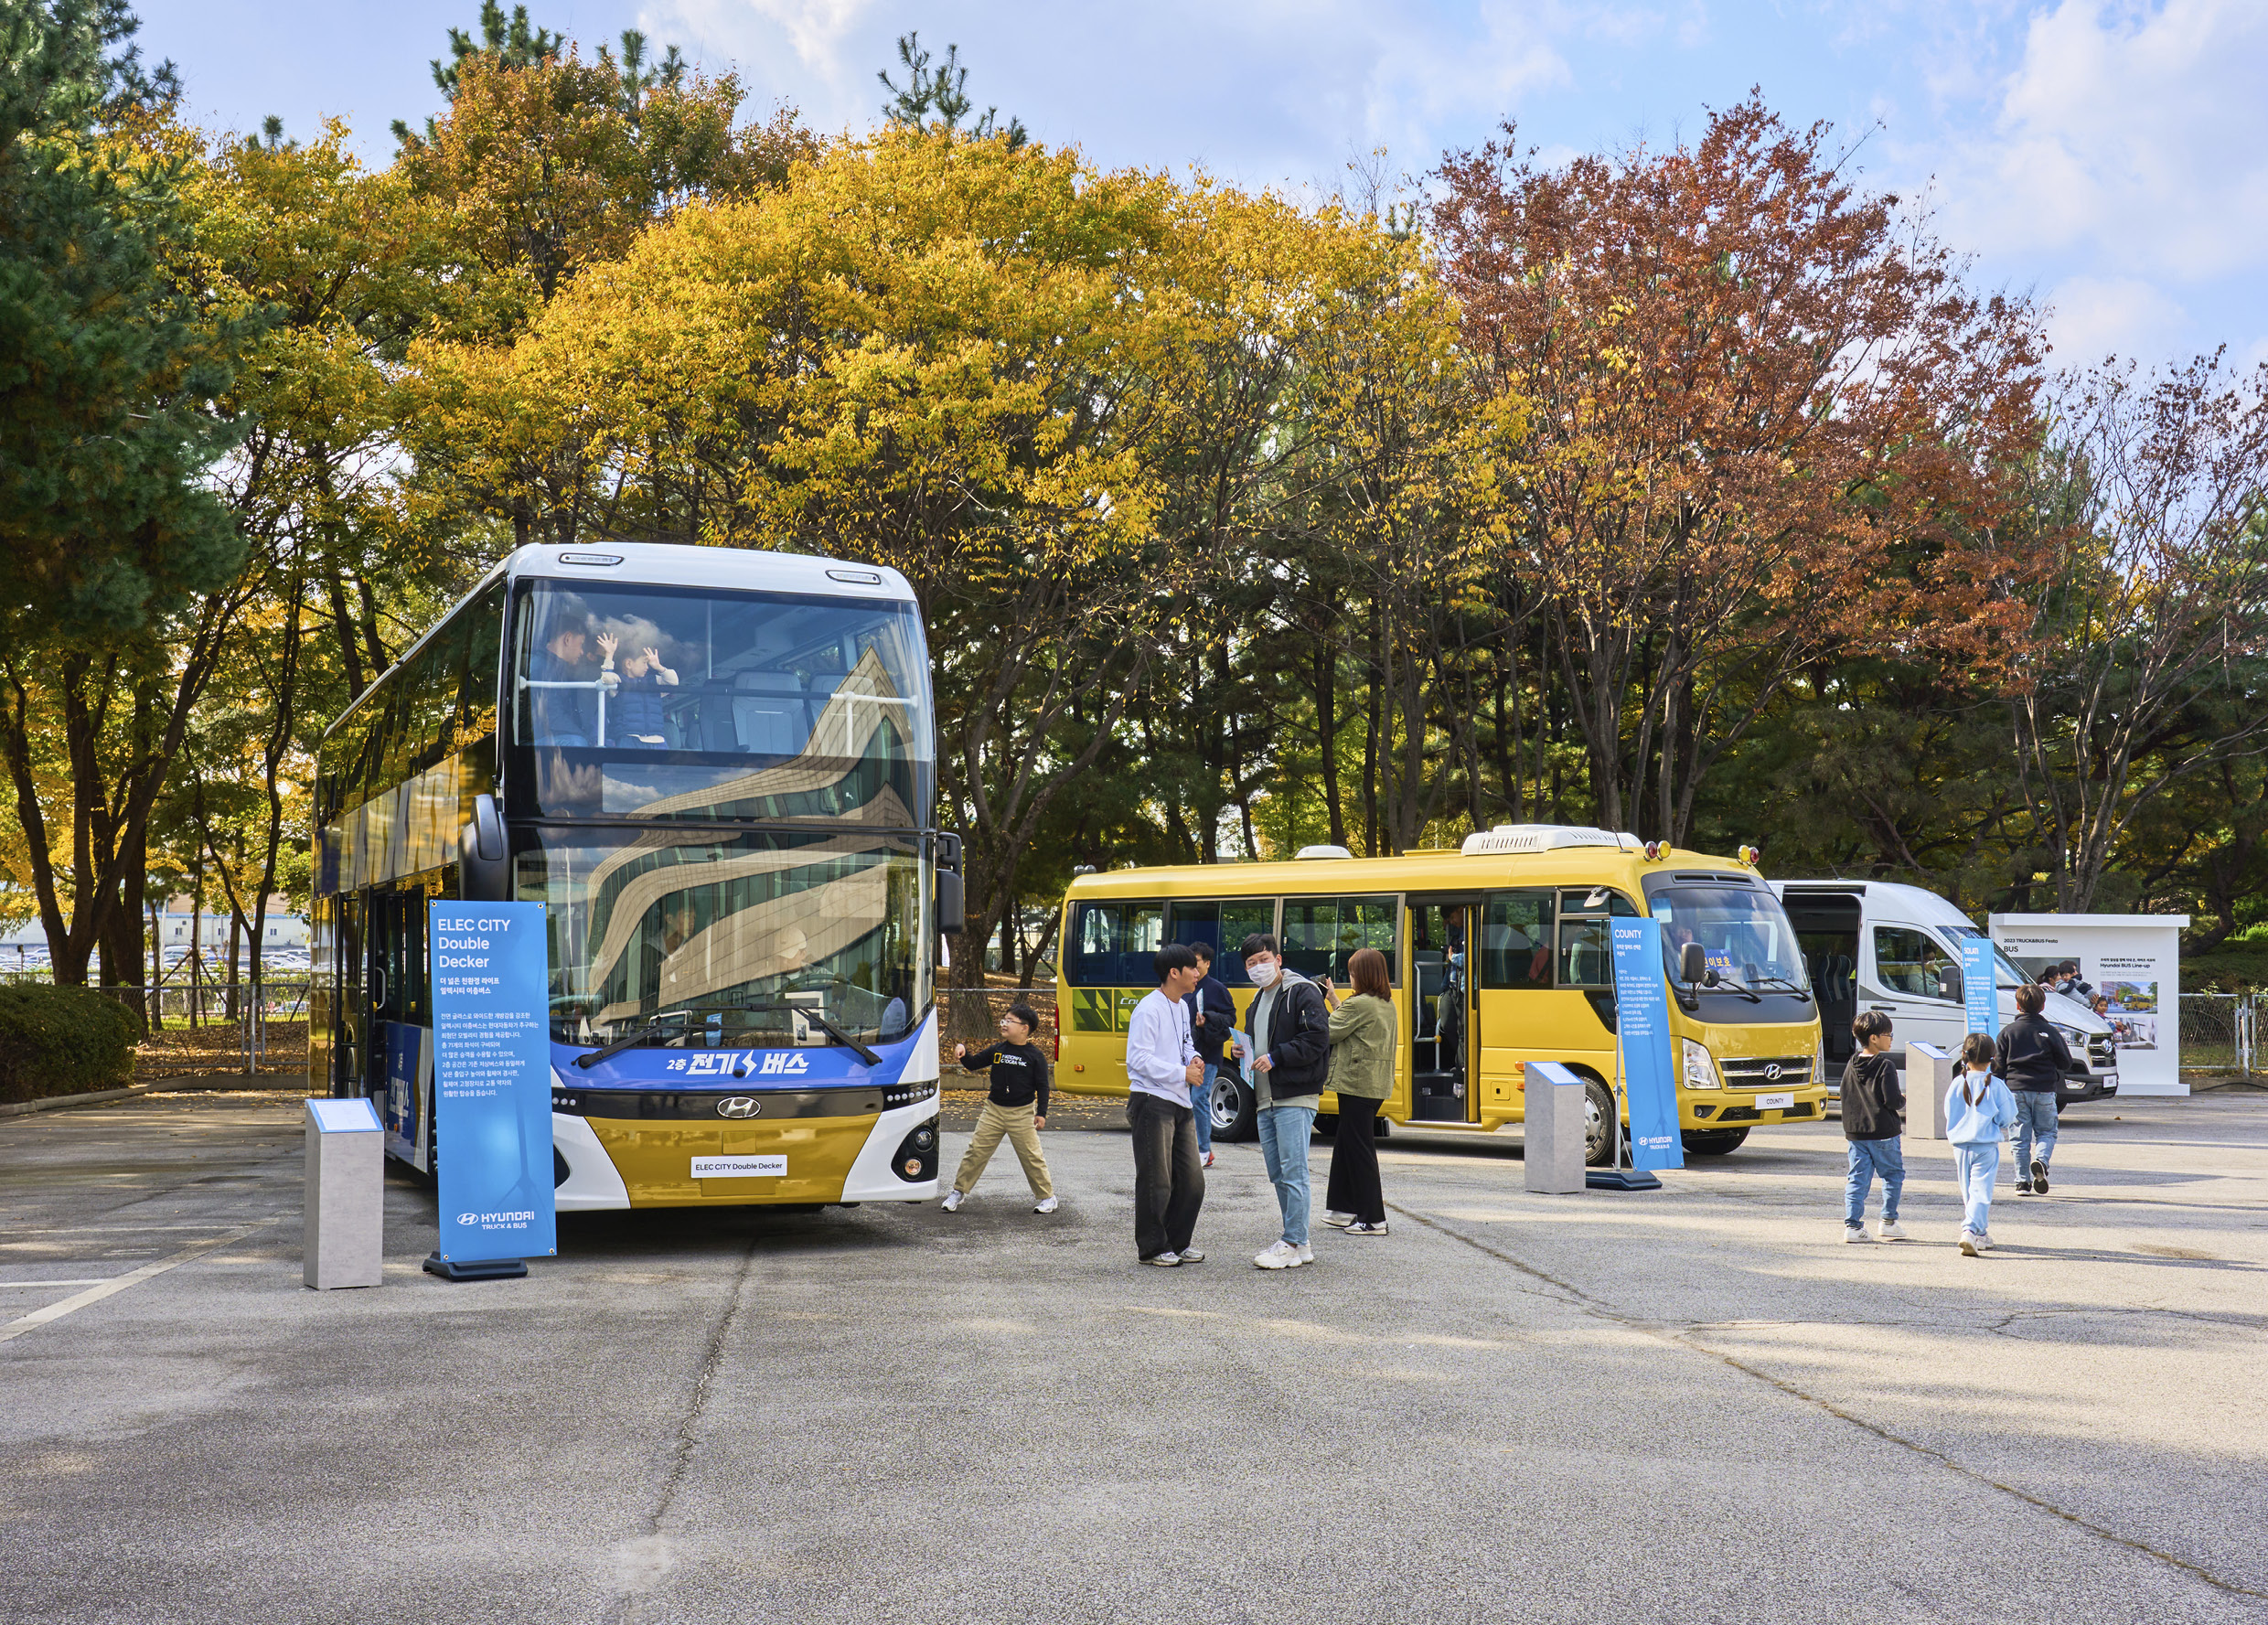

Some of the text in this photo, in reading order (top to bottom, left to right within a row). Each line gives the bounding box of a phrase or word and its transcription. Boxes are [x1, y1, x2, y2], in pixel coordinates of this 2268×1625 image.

[438, 919, 510, 931] ELEC CITY
[1615, 929, 1642, 938] COUNTY
[439, 937, 489, 949] Double
[440, 956, 489, 968] Decker
[667, 1053, 809, 1074] 2층 전기 버스
[482, 1211, 534, 1222] HYUNDAI
